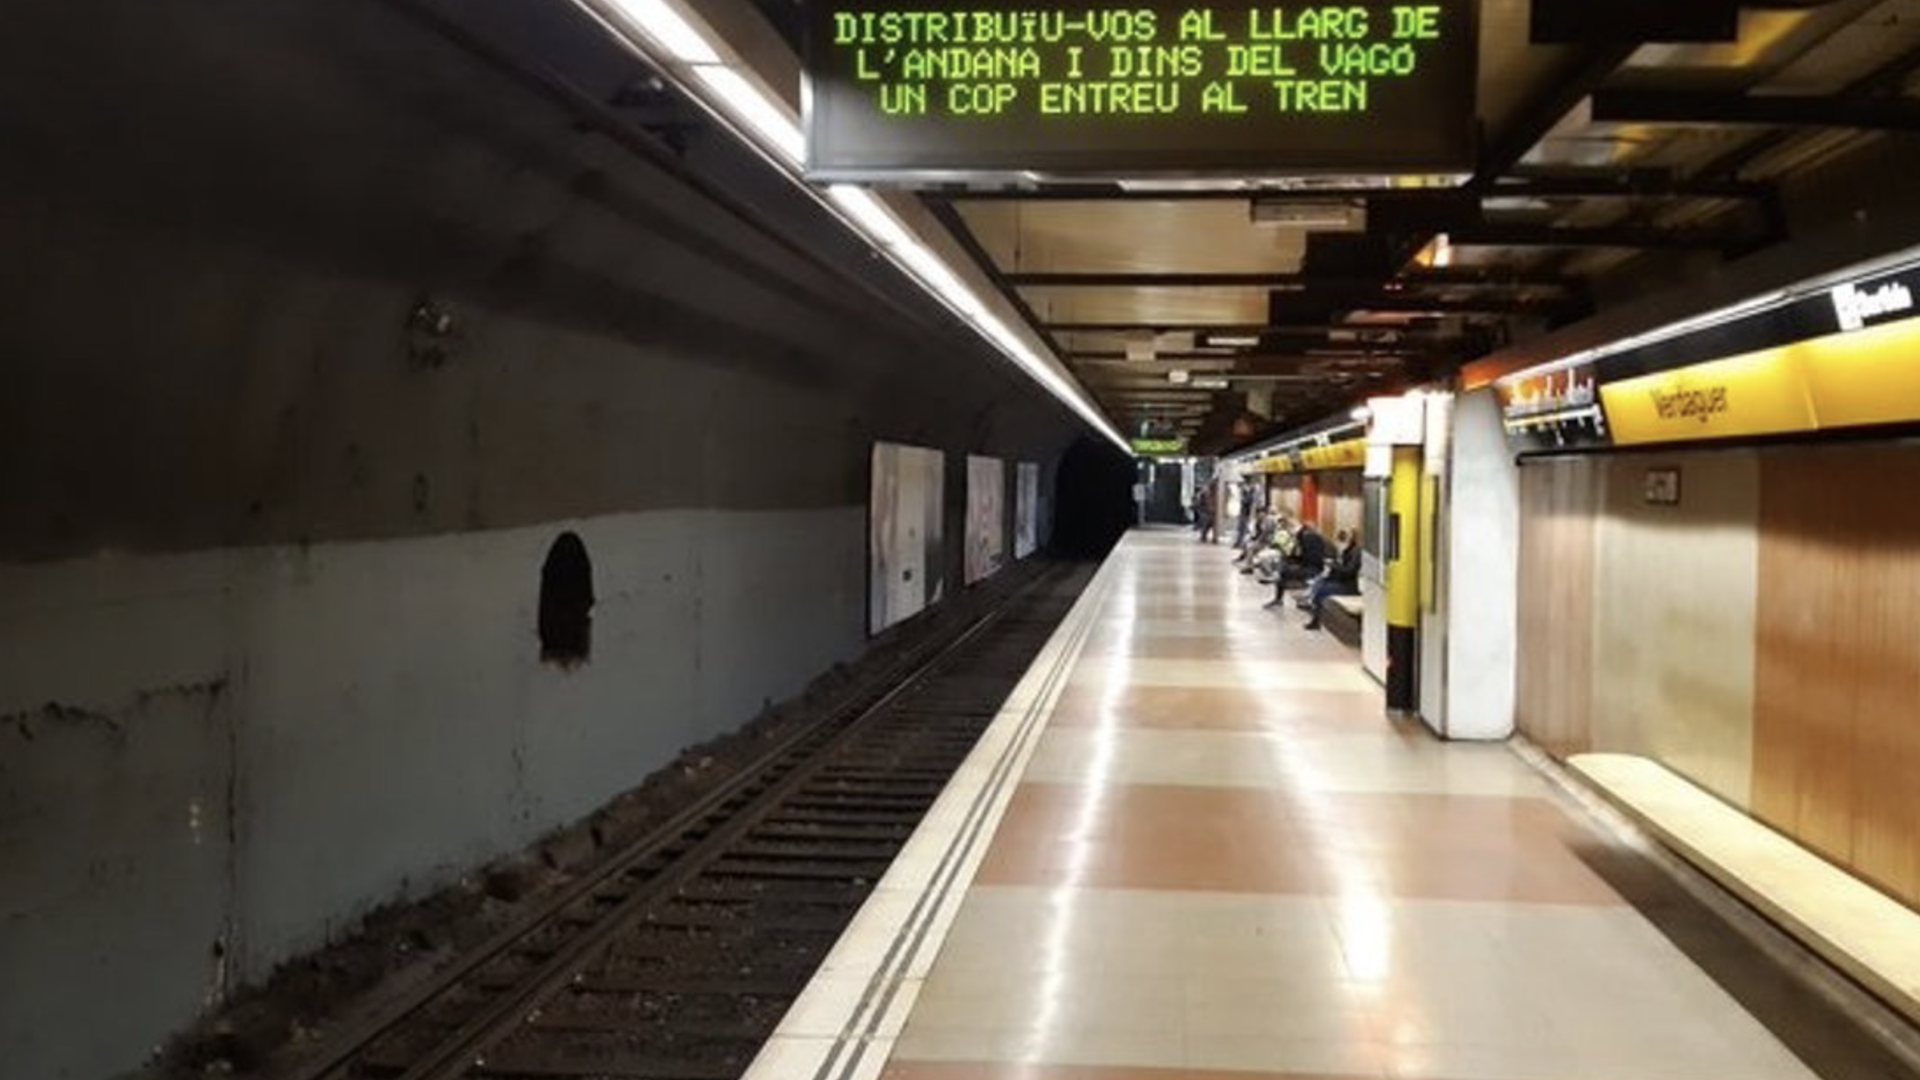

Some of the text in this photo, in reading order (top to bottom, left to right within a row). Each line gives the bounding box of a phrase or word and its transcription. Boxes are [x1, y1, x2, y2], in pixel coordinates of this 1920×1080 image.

[1179, 9, 1226, 41] AL
[1249, 7, 1368, 40] LLARG
[1392, 6, 1440, 38] DE
[857, 43, 1416, 79] L'ANDANA I DINS DEL VAGÓ
[880, 79, 1367, 115] UN COP ENTREU AL TREN
[1650, 386, 1728, 423] Verdaguer
